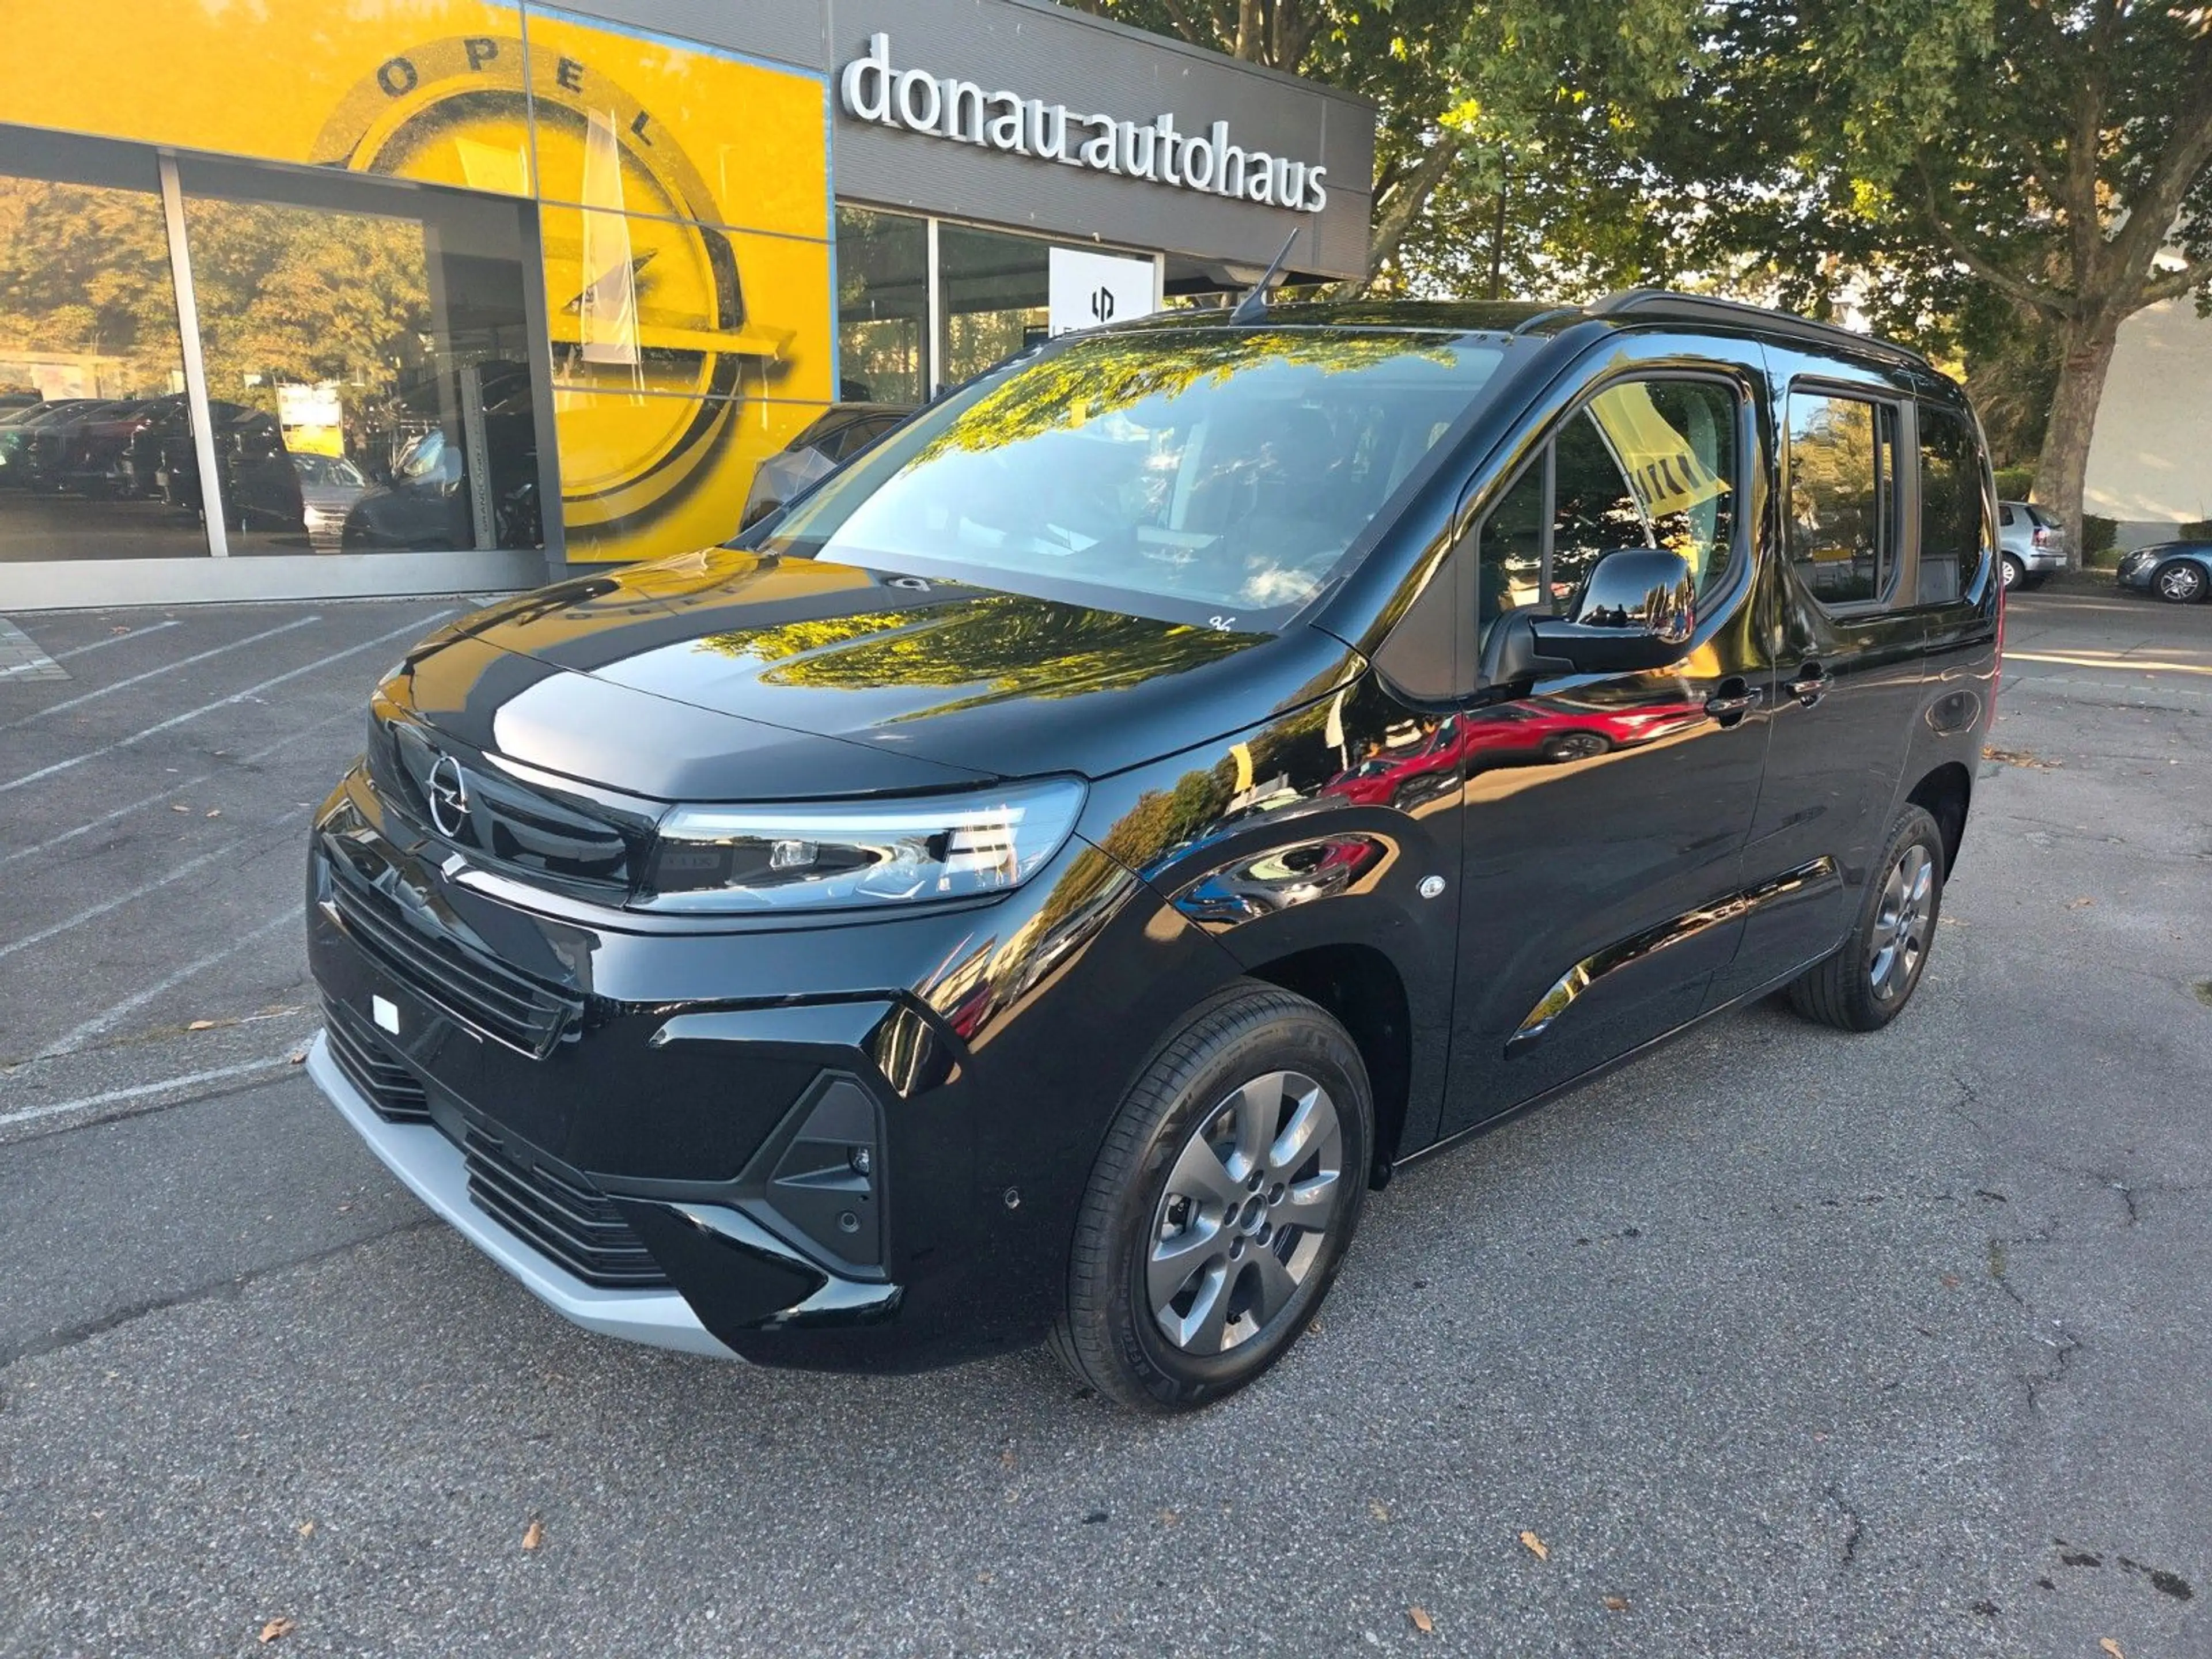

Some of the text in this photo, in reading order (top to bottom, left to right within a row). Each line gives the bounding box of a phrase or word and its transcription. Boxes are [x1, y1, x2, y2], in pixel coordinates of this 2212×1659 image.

[376, 37, 655, 147] OPEL
[841, 32, 1328, 214] donau autohaus
